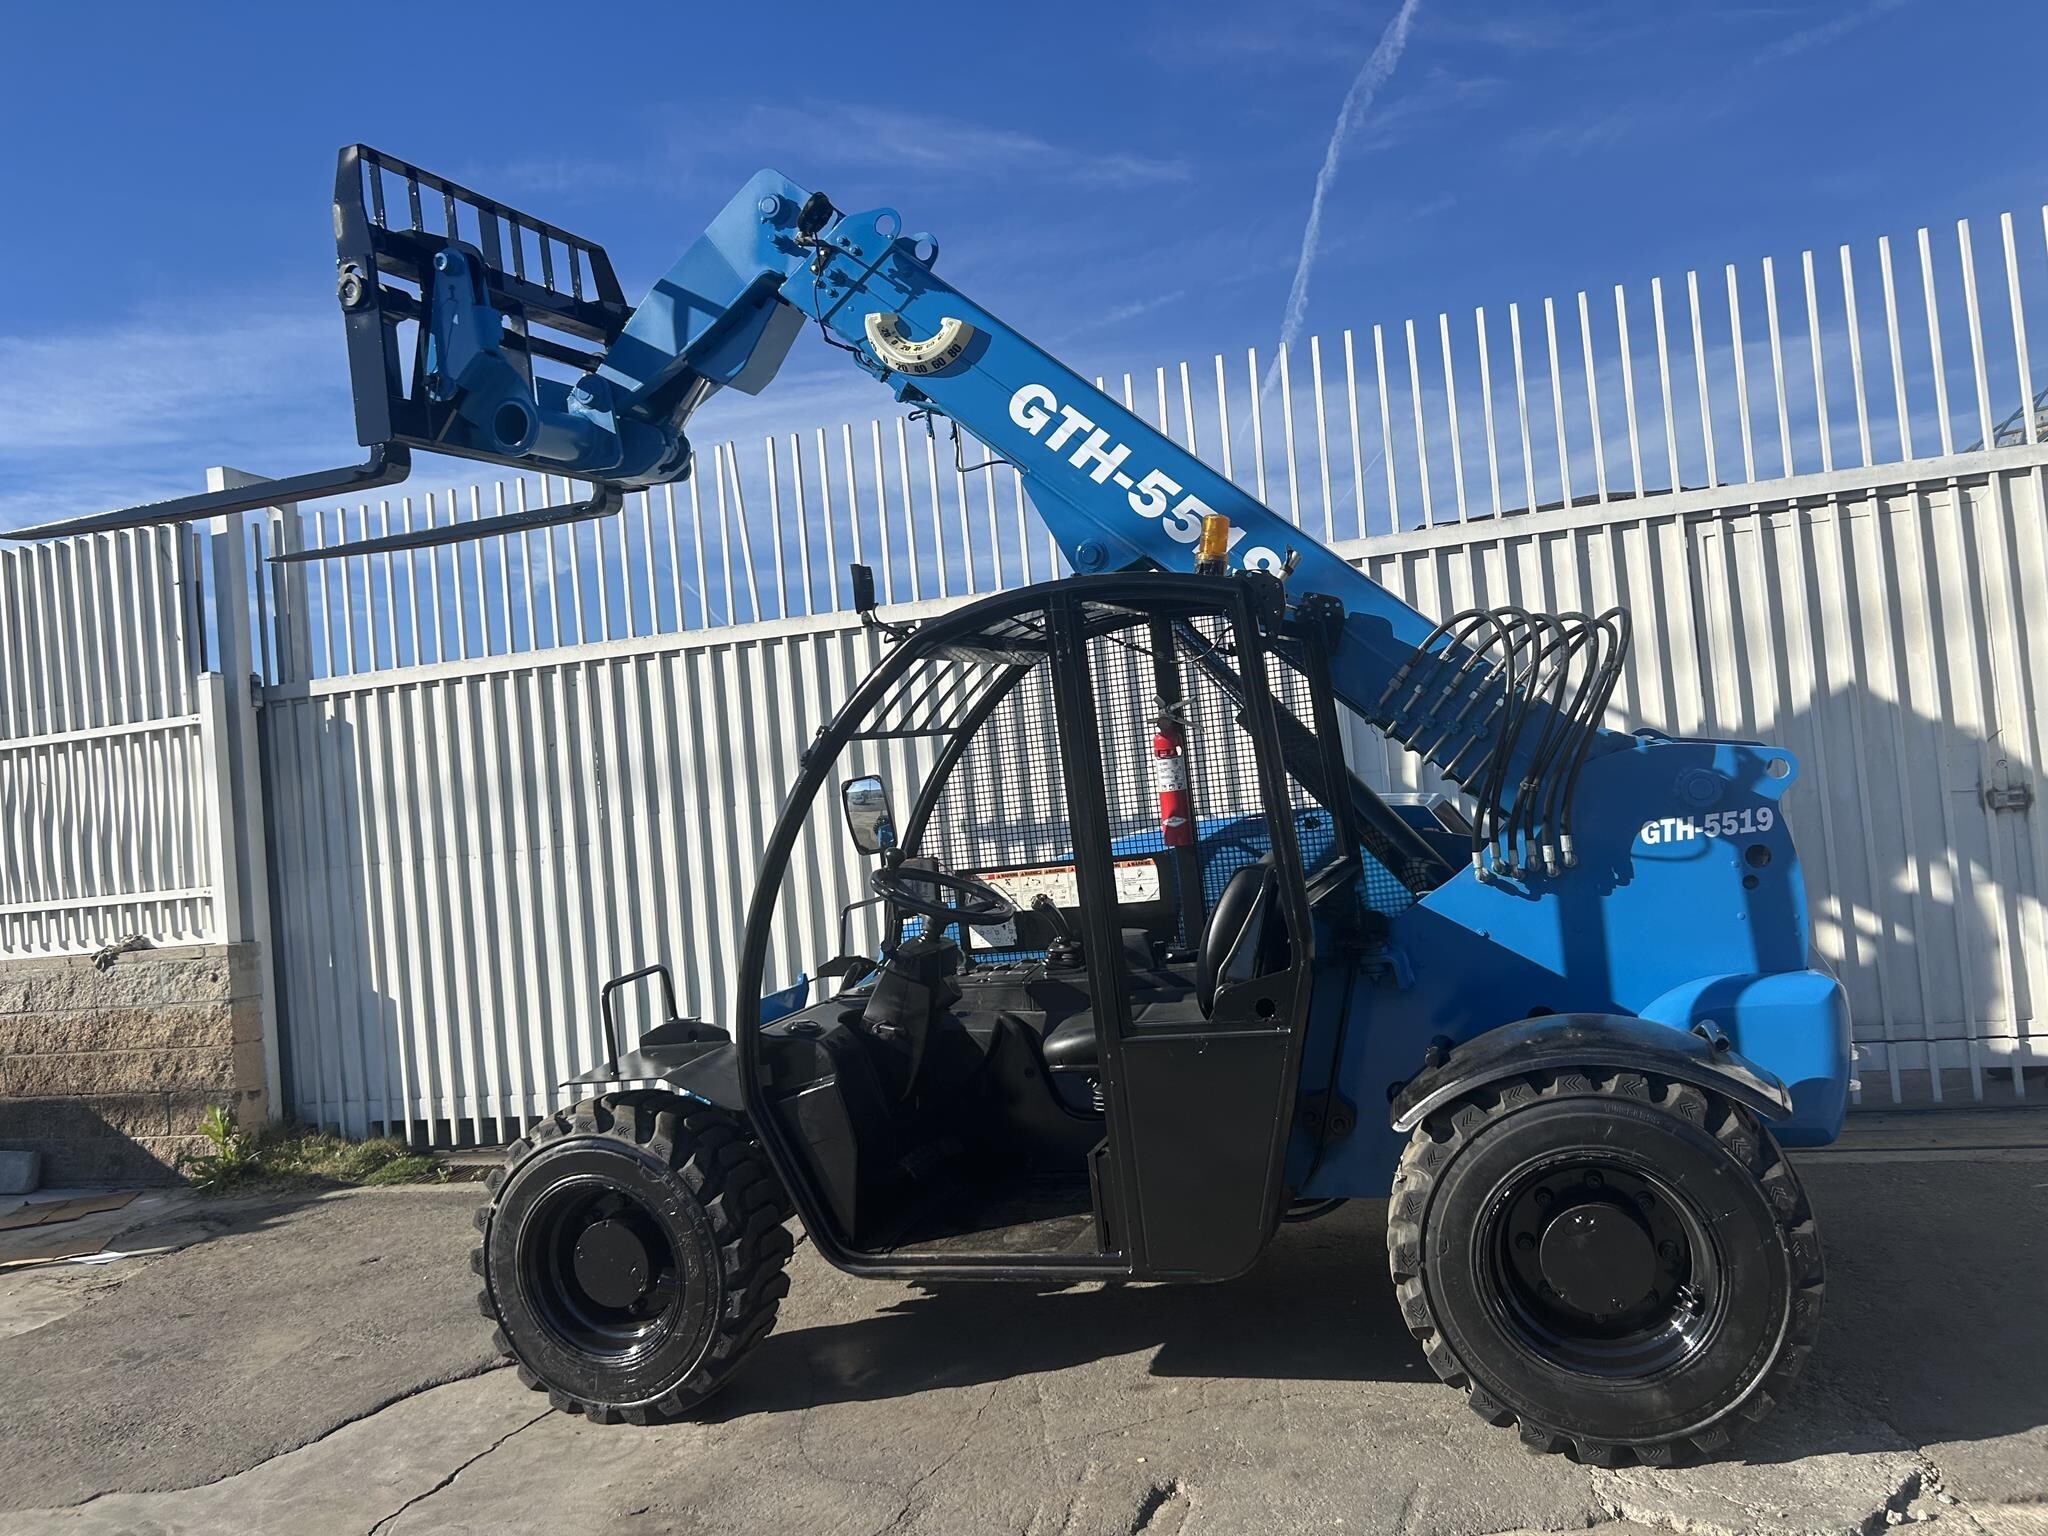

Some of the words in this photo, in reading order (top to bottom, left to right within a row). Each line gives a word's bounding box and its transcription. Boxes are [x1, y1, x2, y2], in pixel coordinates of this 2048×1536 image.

[895, 362, 909, 373] 20
[914, 363, 928, 374] 40
[931, 357, 946, 370] 60
[947, 343, 963, 358] 80
[1640, 806, 1774, 845] GTH-5519
